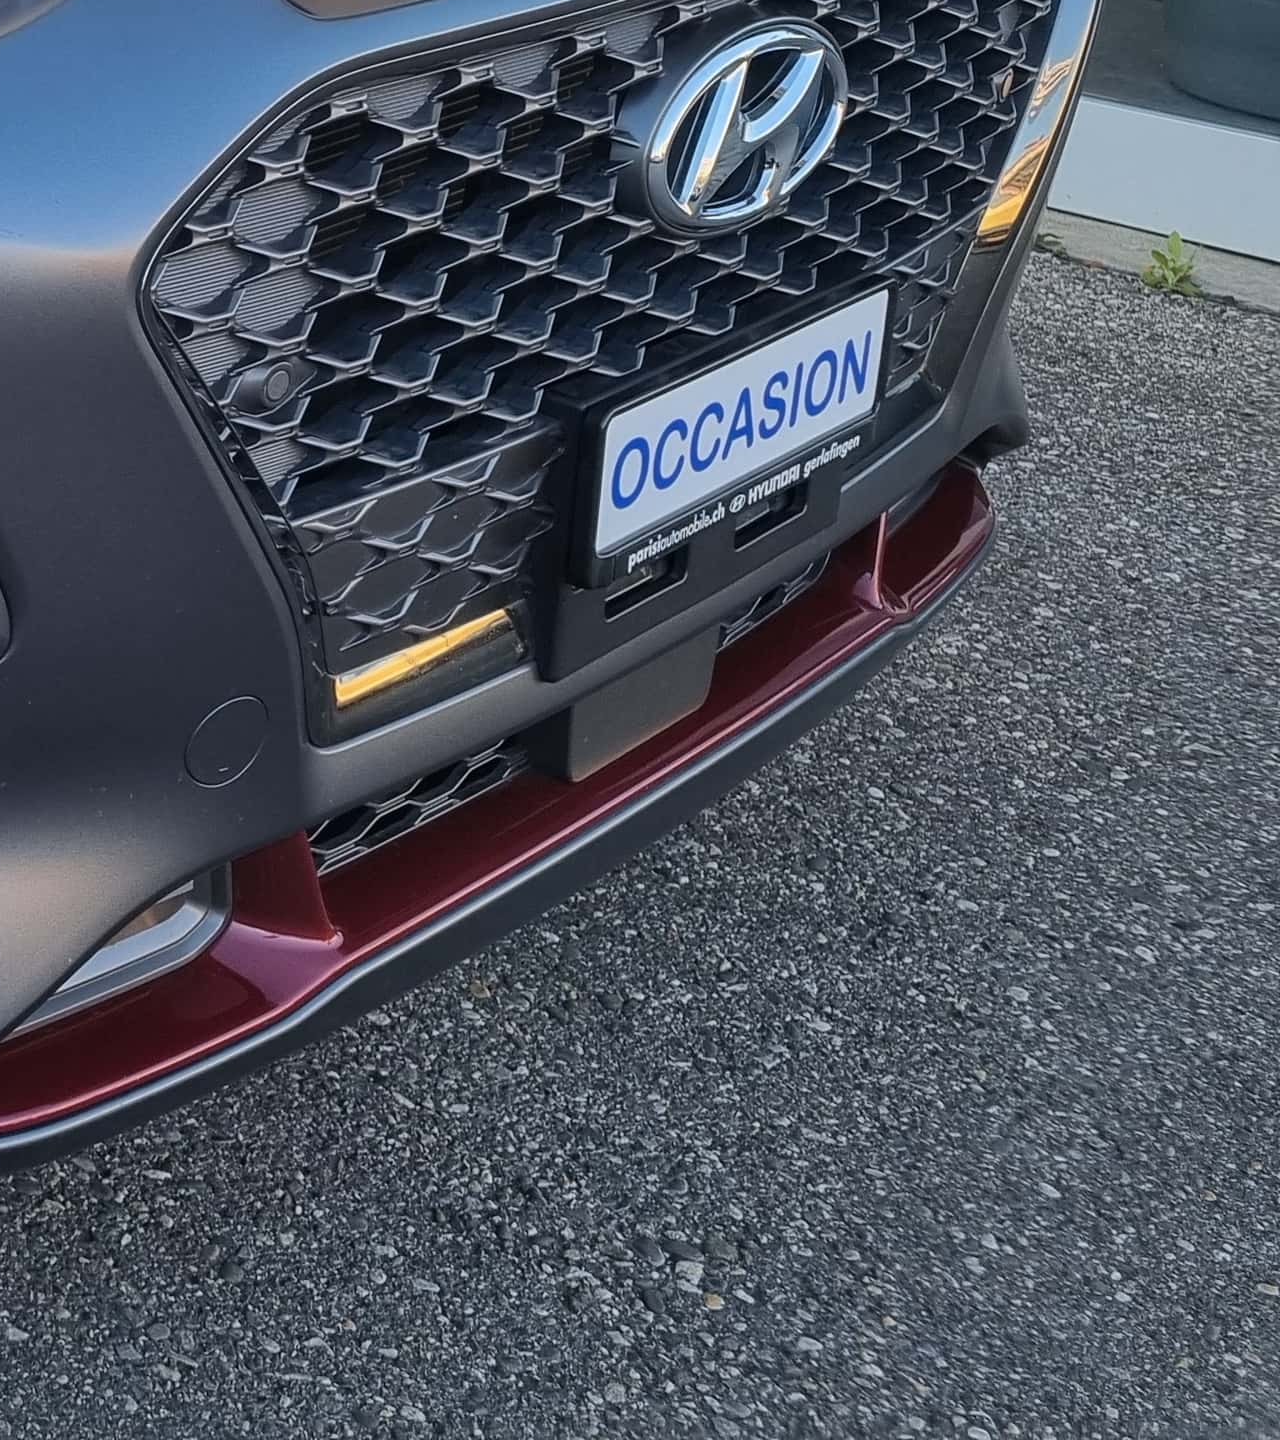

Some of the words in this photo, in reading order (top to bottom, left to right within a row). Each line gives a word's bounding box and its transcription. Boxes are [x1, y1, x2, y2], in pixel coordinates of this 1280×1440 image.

[611, 330, 872, 510] OCCASION
[627, 501, 725, 573] parisiautomobile.ch
[747, 463, 800, 506] HYUNDAI
[803, 434, 861, 478] gerlafingen
